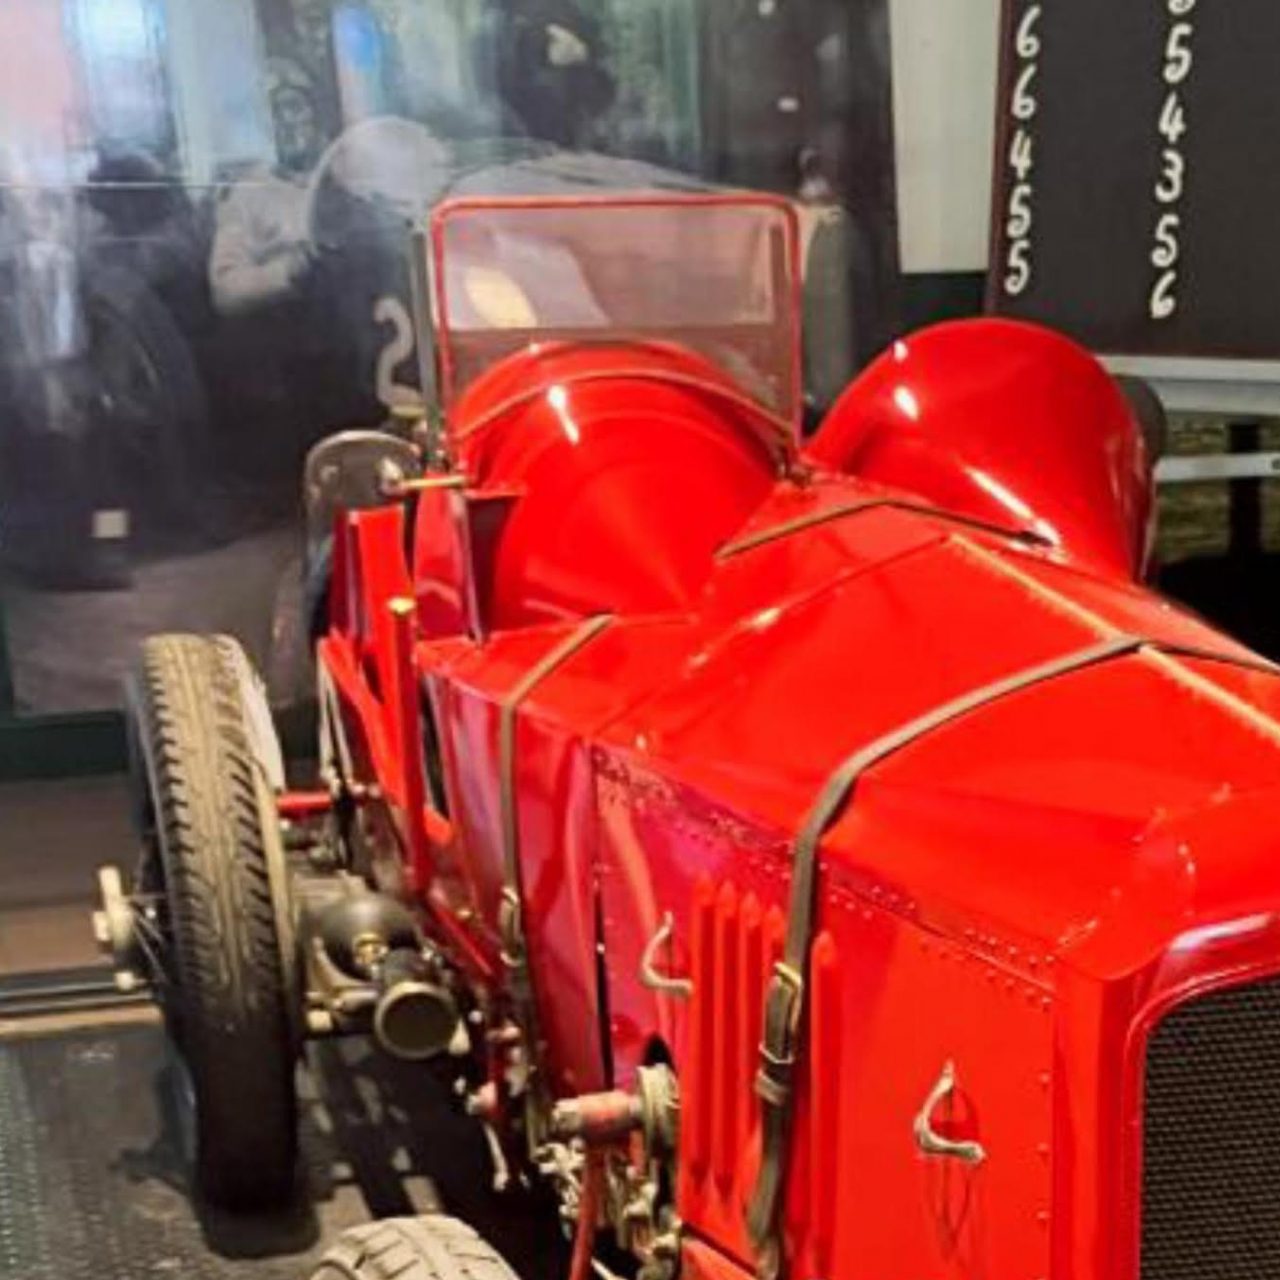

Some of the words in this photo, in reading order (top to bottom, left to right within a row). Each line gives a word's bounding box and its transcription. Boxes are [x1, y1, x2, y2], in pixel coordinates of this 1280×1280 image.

[1017, 6, 1041, 58] 6
[1163, 24, 1192, 83] 5
[1012, 65, 1037, 119] 6
[1159, 93, 1186, 143] 4
[1010, 130, 1032, 180] 4
[1155, 150, 1184, 202] 3
[1007, 185, 1031, 238] 5
[1152, 214, 1179, 267] 5
[1004, 240, 1030, 295] 5
[1150, 271, 1176, 318] 6
